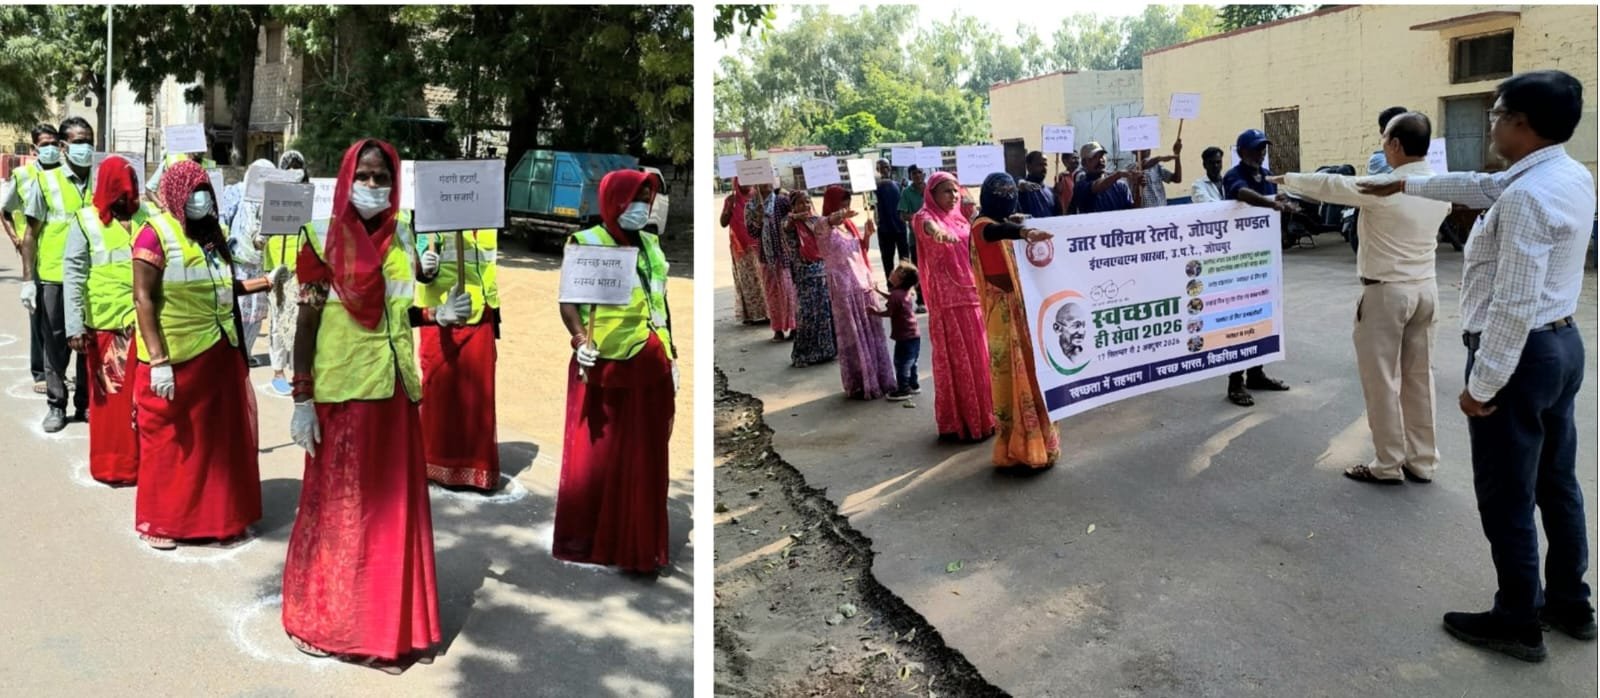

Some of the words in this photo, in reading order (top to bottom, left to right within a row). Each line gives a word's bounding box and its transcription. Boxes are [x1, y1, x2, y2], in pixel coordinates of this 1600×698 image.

[1066, 234, 1097, 253] उत्तर
[1099, 228, 1146, 248] पश्चिम
[1147, 222, 1183, 242] रेलवे,
[1187, 219, 1229, 239] जोधपुर
[1234, 214, 1270, 231] मण्डल
[576, 258, 600, 268] स्वच्छ
[602, 258, 623, 270] भारत,
[1140, 250, 1168, 264] शाखा,
[1203, 240, 1231, 254] जोधपुर
[1091, 296, 1182, 329] स्वच्छता
[1094, 329, 1109, 349] ही
[1111, 326, 1139, 345] सेवा
[1142, 319, 1183, 339] 2026
[1137, 345, 1141, 353] 2
[1163, 338, 1180, 348] 2026
[1155, 362, 1179, 376] स्वच्छ
[1181, 358, 1205, 371] भारत,
[1207, 349, 1238, 365] विकसित
[1240, 345, 1258, 357] भारत
[1069, 381, 1101, 399] स्वच्छता
[1102, 375, 1111, 390] में
[1112, 371, 1143, 387] सहभाग
